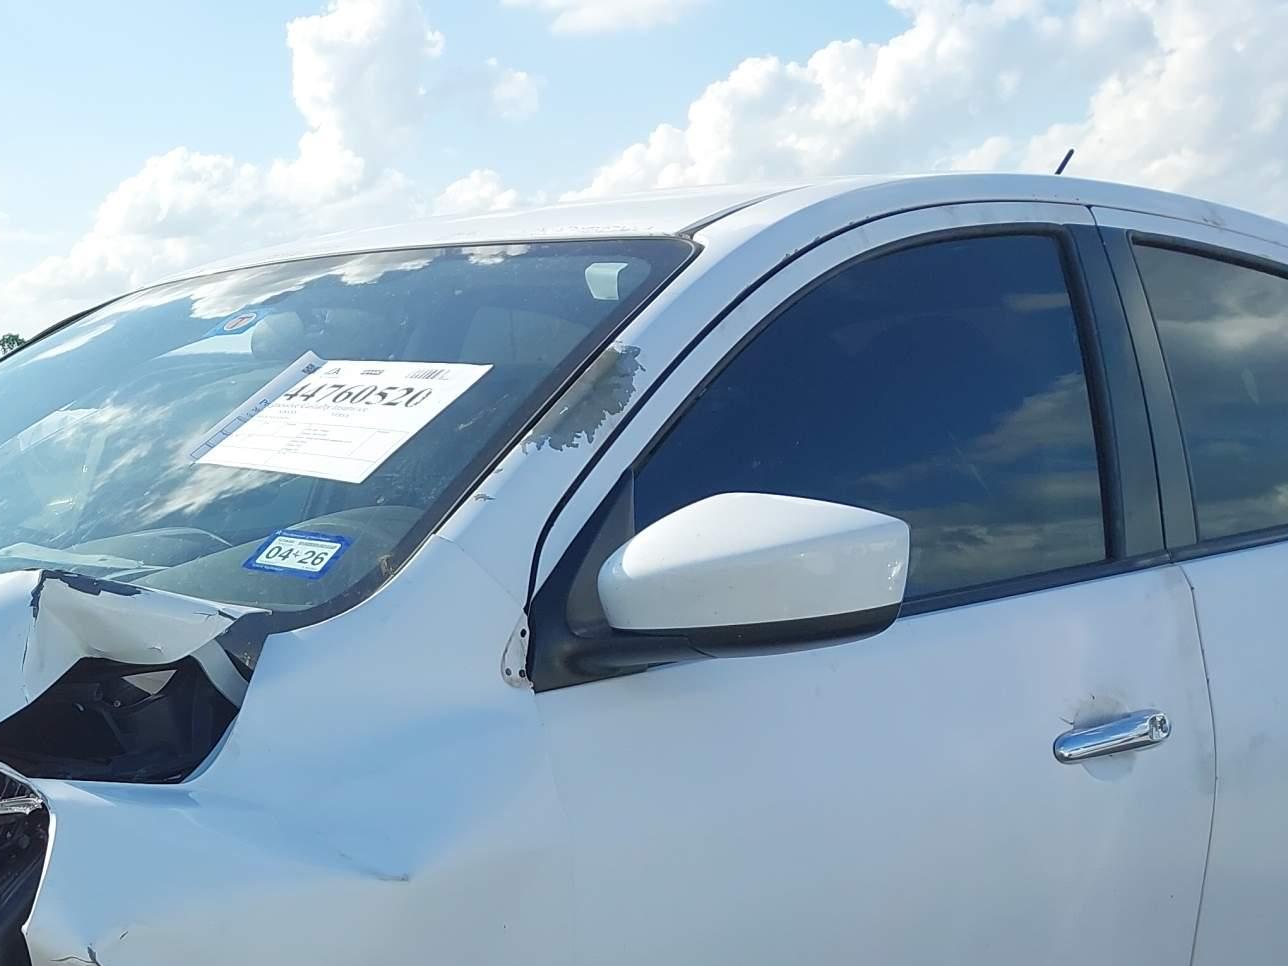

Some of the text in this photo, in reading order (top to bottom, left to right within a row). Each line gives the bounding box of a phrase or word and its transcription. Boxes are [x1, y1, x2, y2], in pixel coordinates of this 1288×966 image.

[283, 383, 433, 408] 44760520
[265, 545, 329, 566] 04 26
